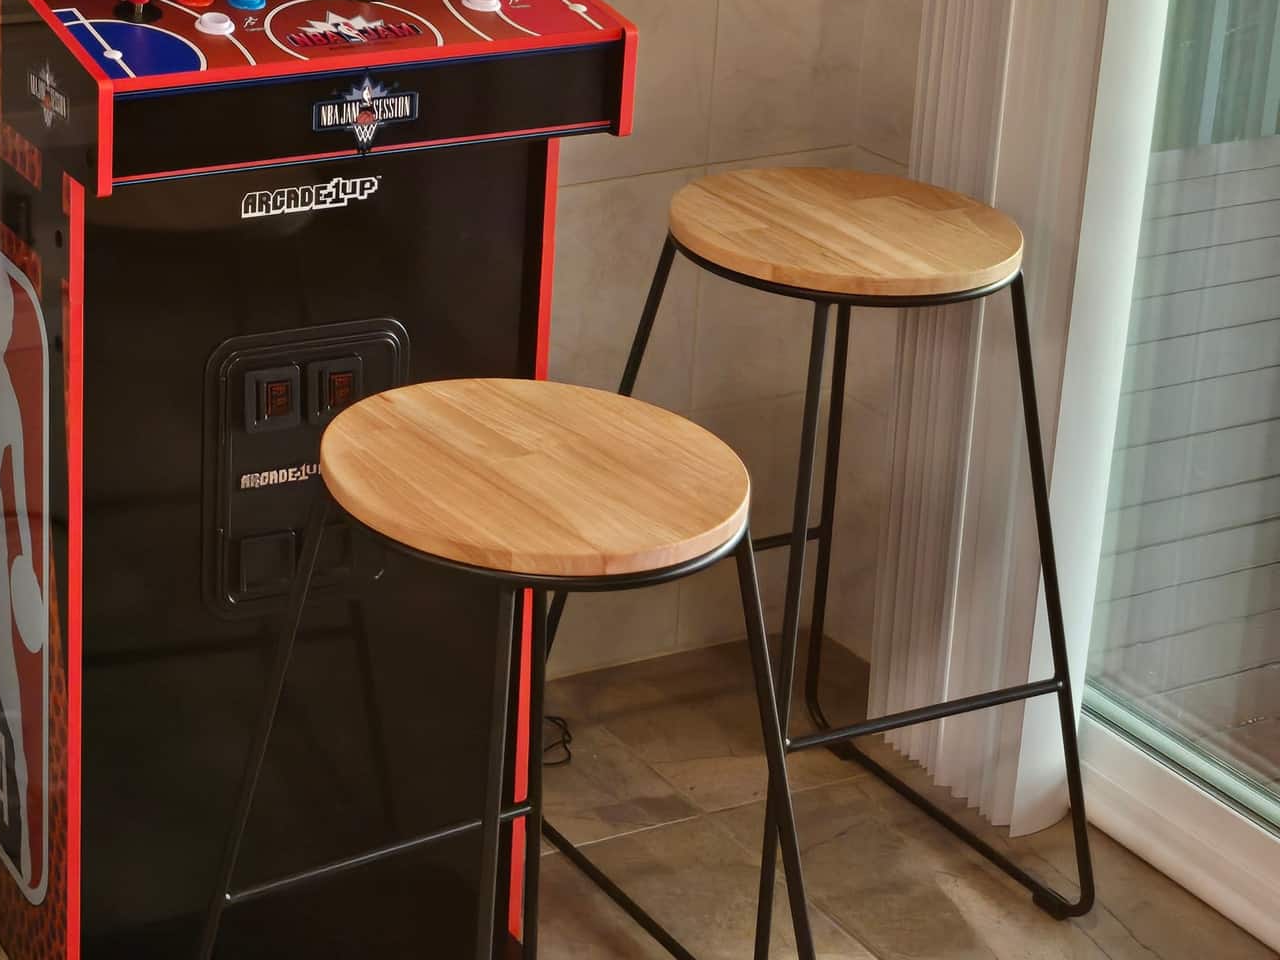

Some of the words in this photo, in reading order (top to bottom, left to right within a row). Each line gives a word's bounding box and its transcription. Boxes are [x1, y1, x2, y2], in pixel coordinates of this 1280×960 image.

[320, 104, 339, 127] NBA
[373, 95, 412, 121] SESSION
[241, 463, 321, 489] ARCADE1U
